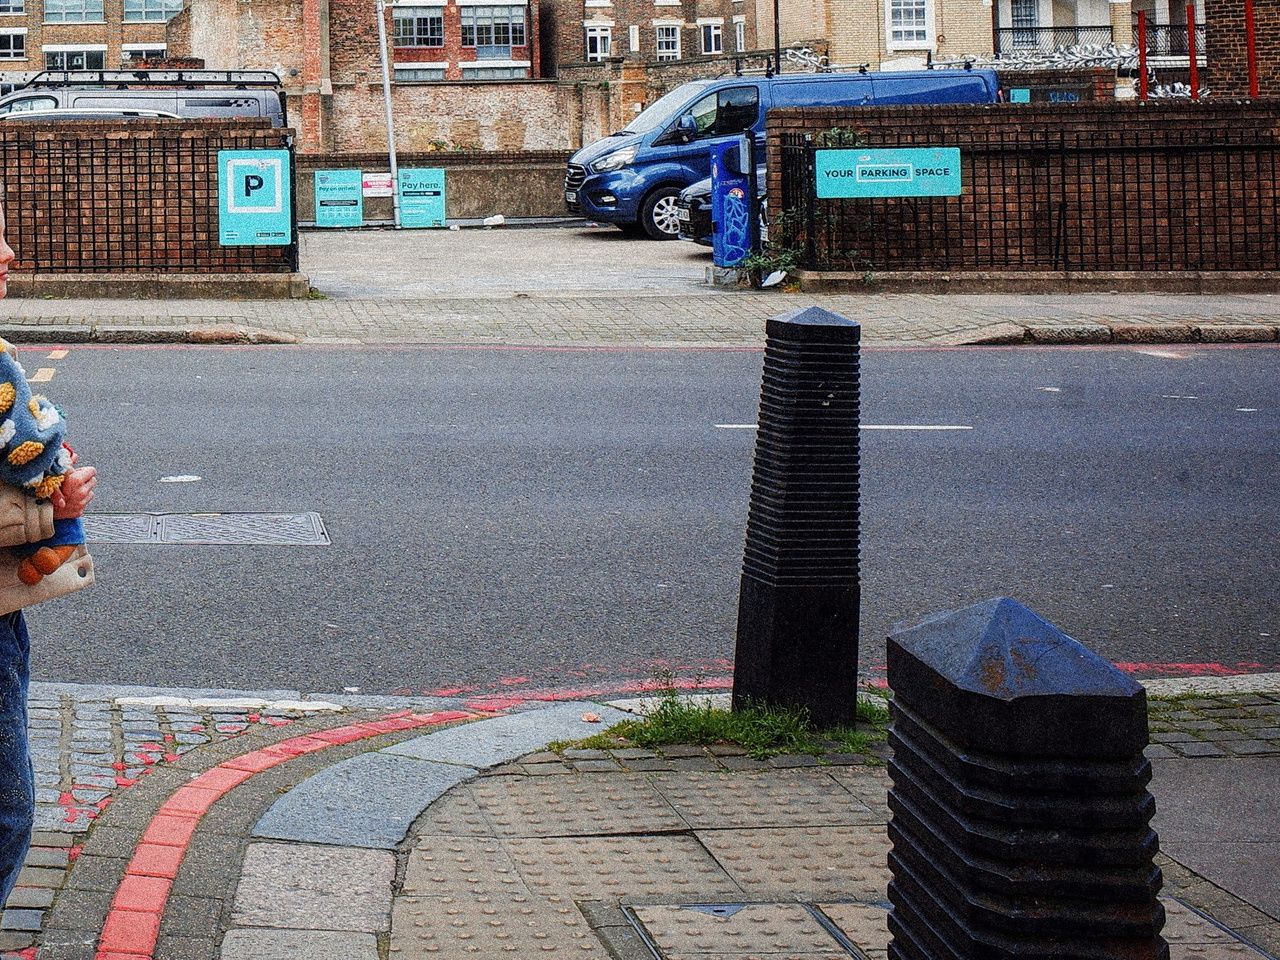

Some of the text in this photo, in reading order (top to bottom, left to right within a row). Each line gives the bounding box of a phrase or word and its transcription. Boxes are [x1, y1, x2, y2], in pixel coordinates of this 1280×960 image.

[824, 167, 950, 178] YOUR PARKING SPACE
[245, 175, 264, 197] P
[402, 181, 441, 190] Pay here.
